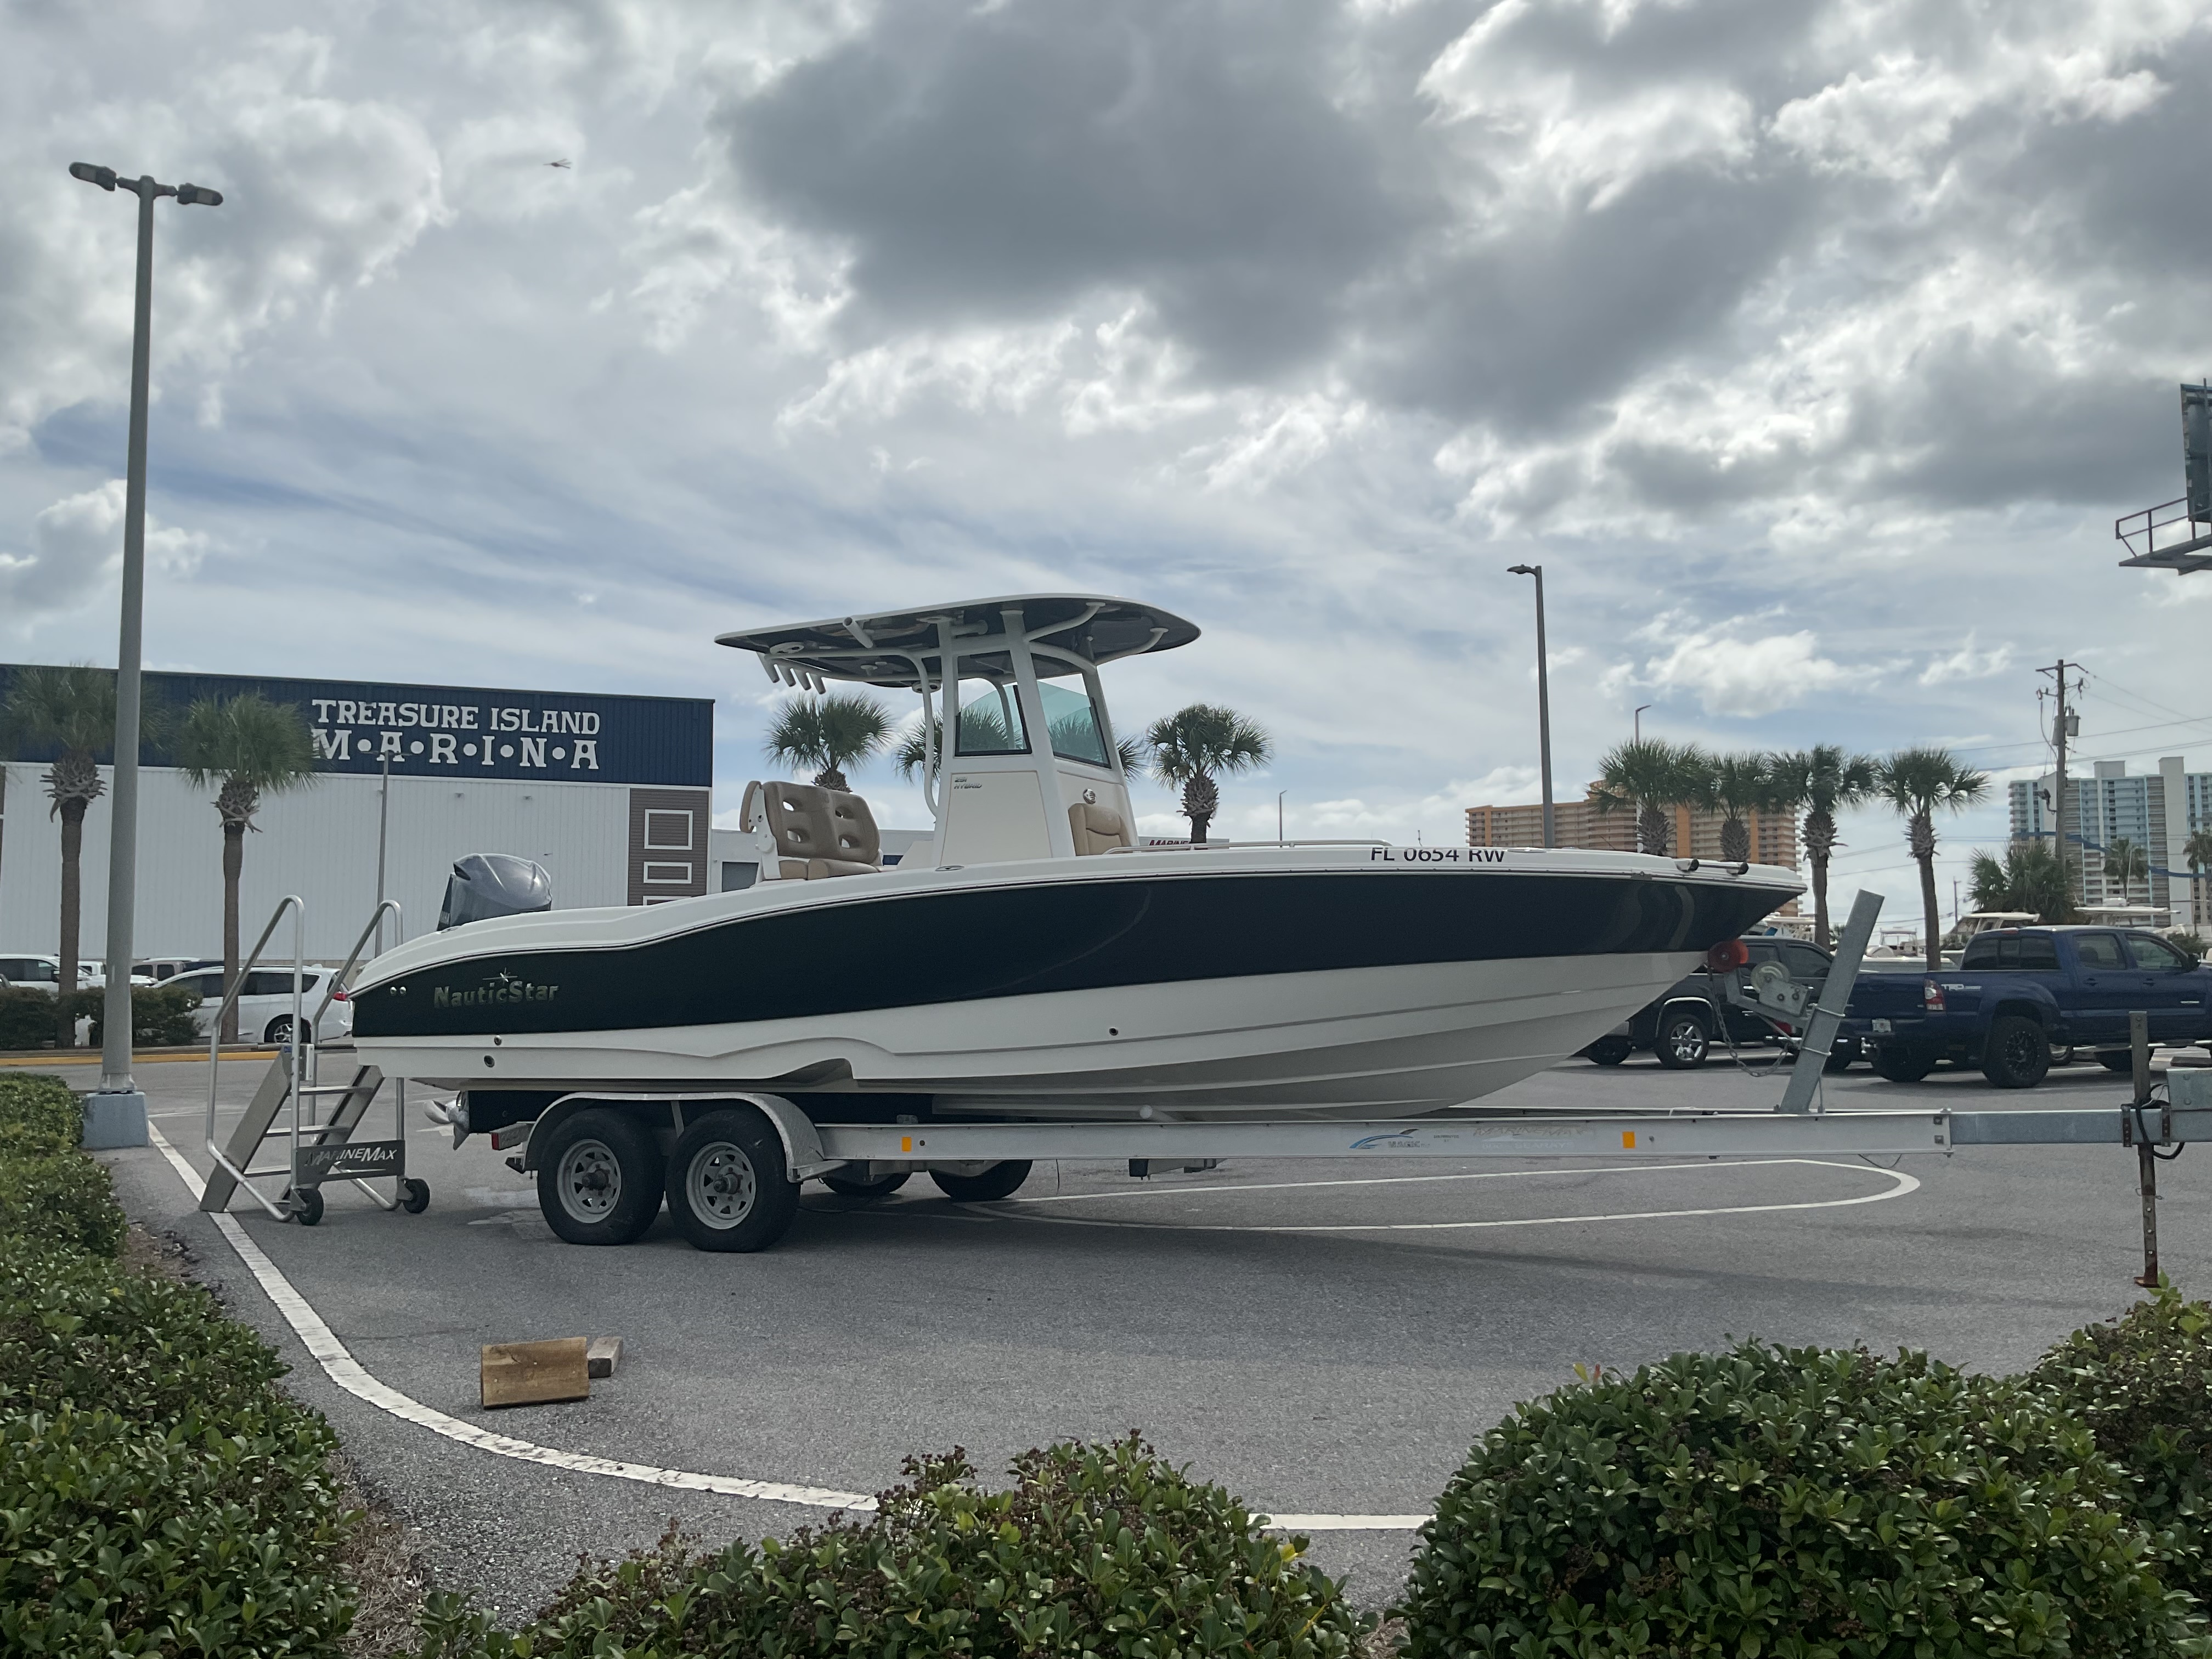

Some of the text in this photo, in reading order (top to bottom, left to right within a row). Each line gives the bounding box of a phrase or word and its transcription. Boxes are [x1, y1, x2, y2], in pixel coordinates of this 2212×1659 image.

[312, 699, 600, 735] TREASURE ISLAND
[1371, 847, 1505, 862] FL 0654 RW
[433, 980, 560, 1008] NauticStar
